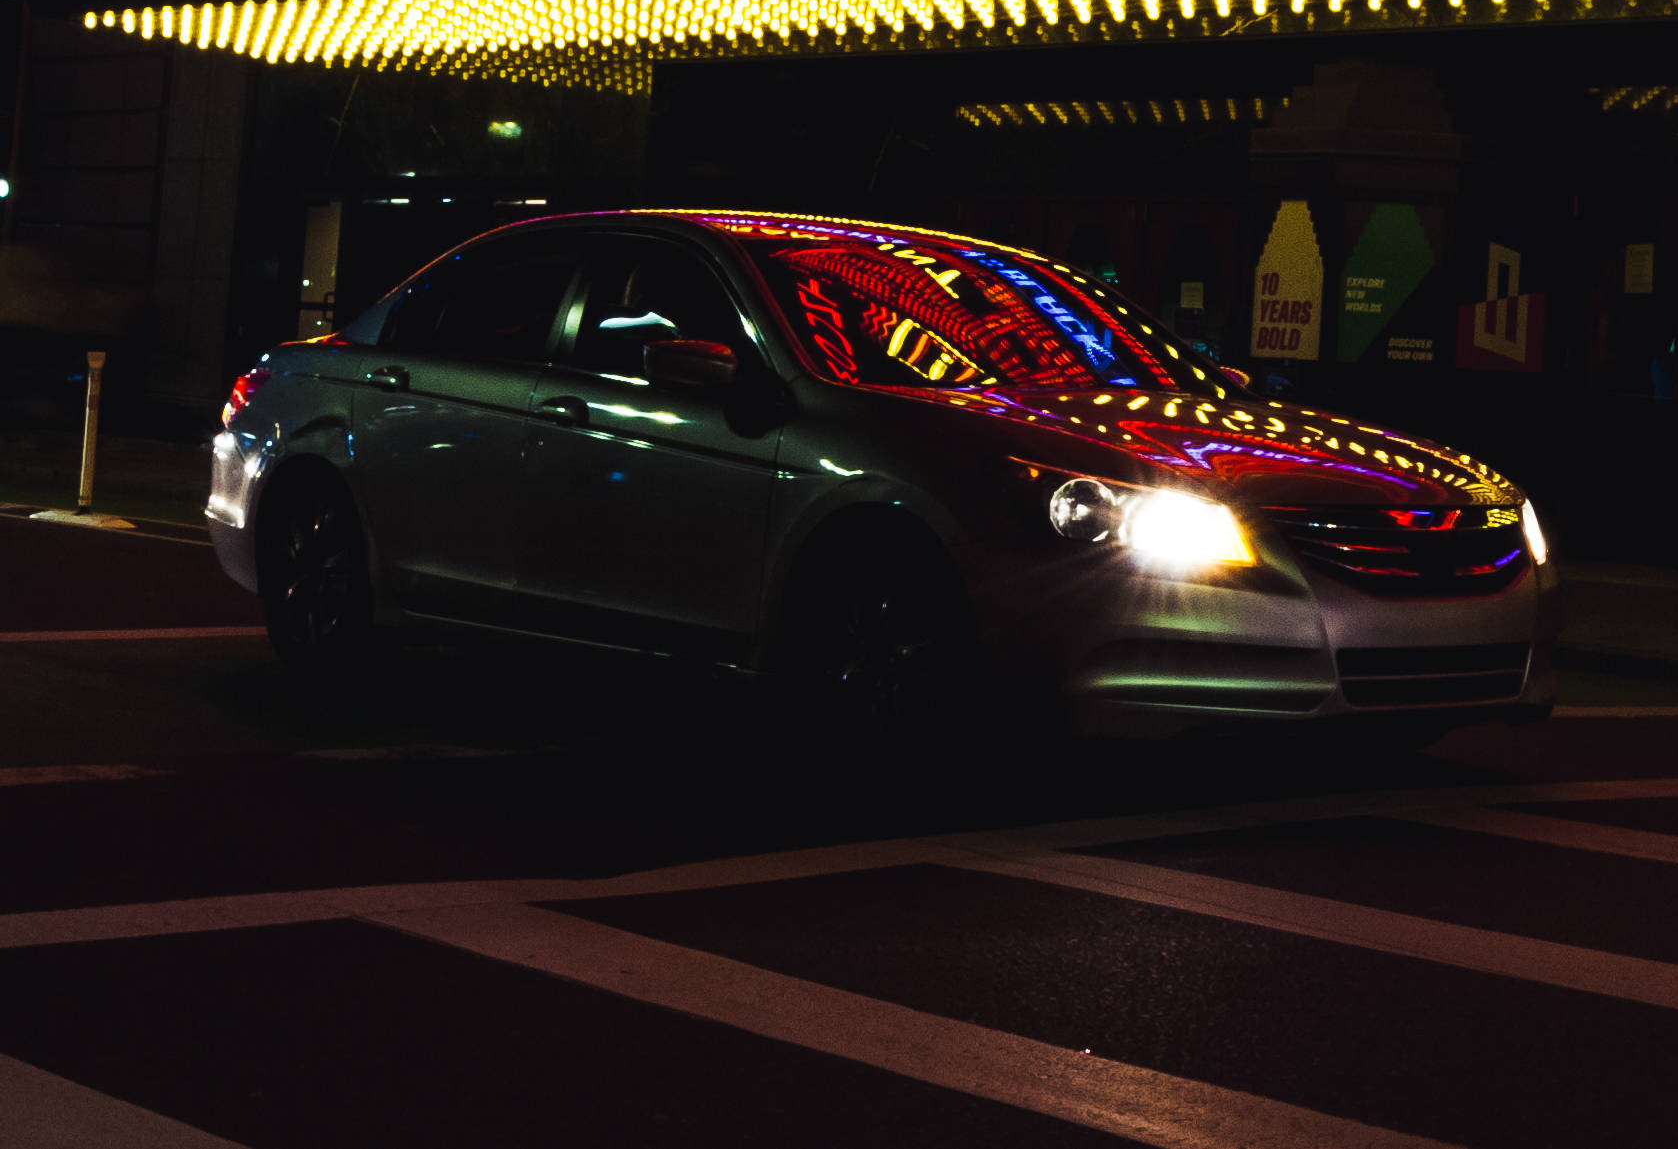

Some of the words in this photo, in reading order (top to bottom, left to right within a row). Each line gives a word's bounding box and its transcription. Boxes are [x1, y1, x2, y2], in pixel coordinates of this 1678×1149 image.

[1261, 272, 1280, 296] 10
[1344, 289, 1367, 300] NEW
[1345, 277, 1386, 289] EXPLORE
[1260, 299, 1313, 325] YEARS
[1256, 326, 1301, 351] BOLD
